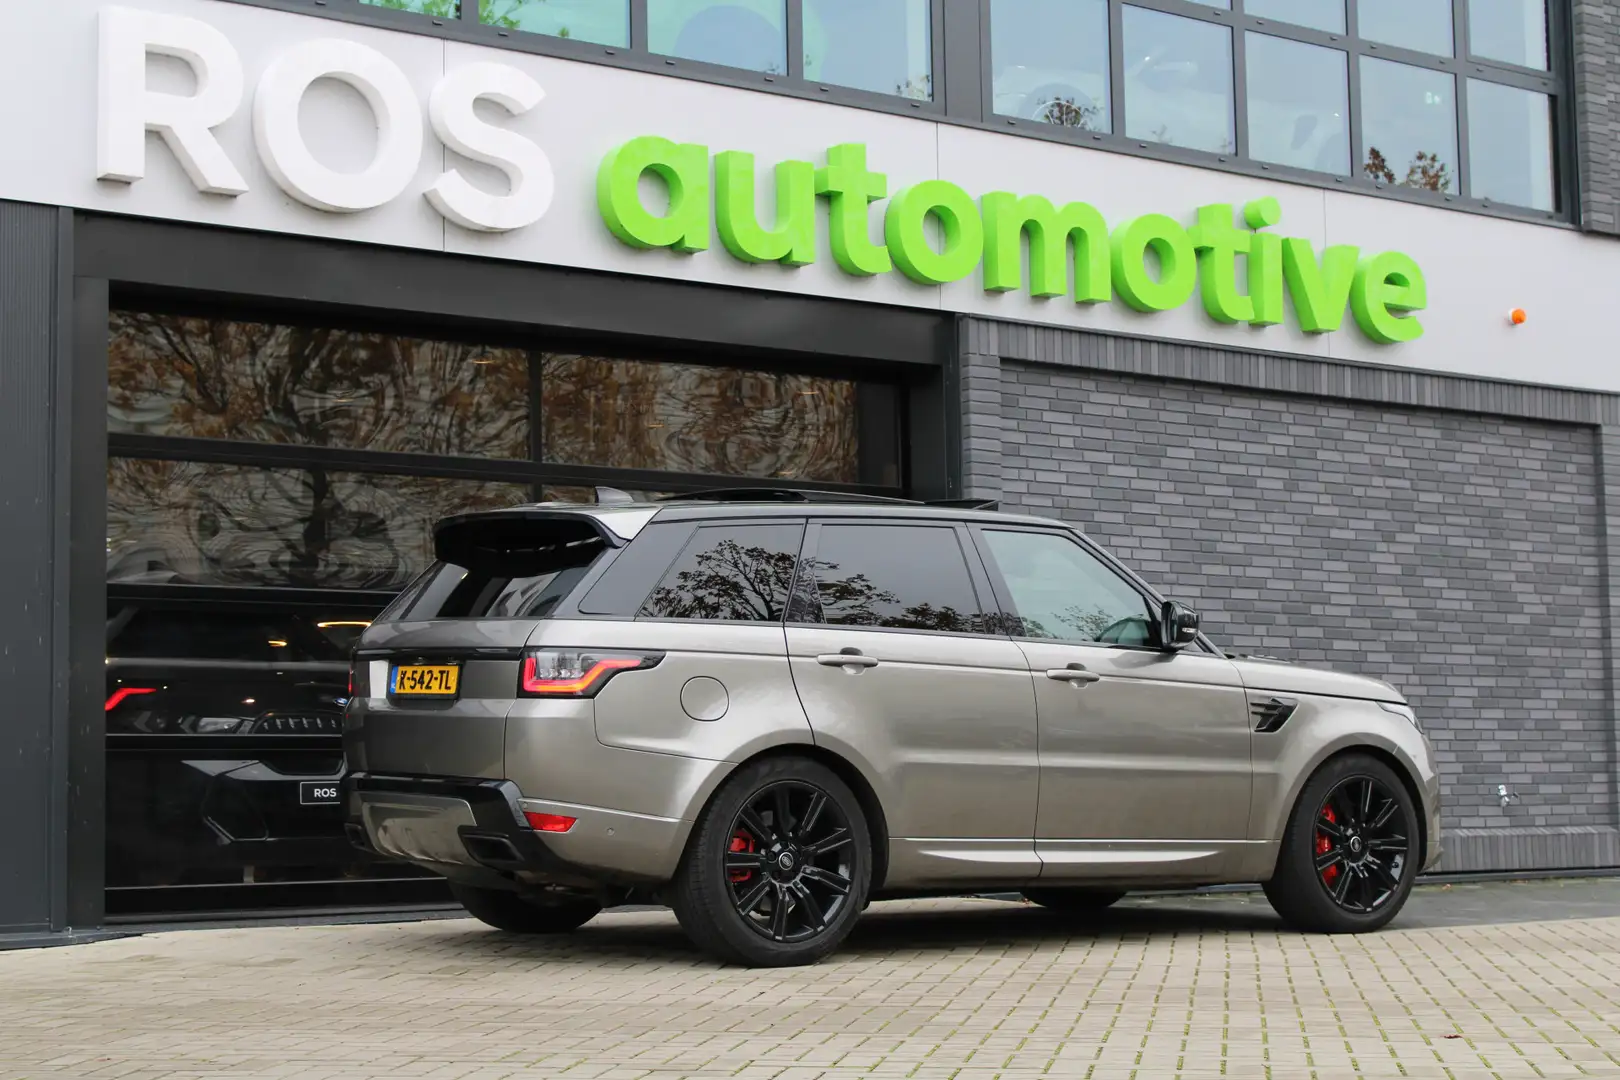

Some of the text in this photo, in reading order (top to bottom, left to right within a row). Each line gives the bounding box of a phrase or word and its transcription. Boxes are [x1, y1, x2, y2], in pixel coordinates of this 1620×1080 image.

[97, 9, 1427, 345] ROS automotive
[398, 669, 452, 690] K-542-TL
[313, 788, 337, 798] ROS
